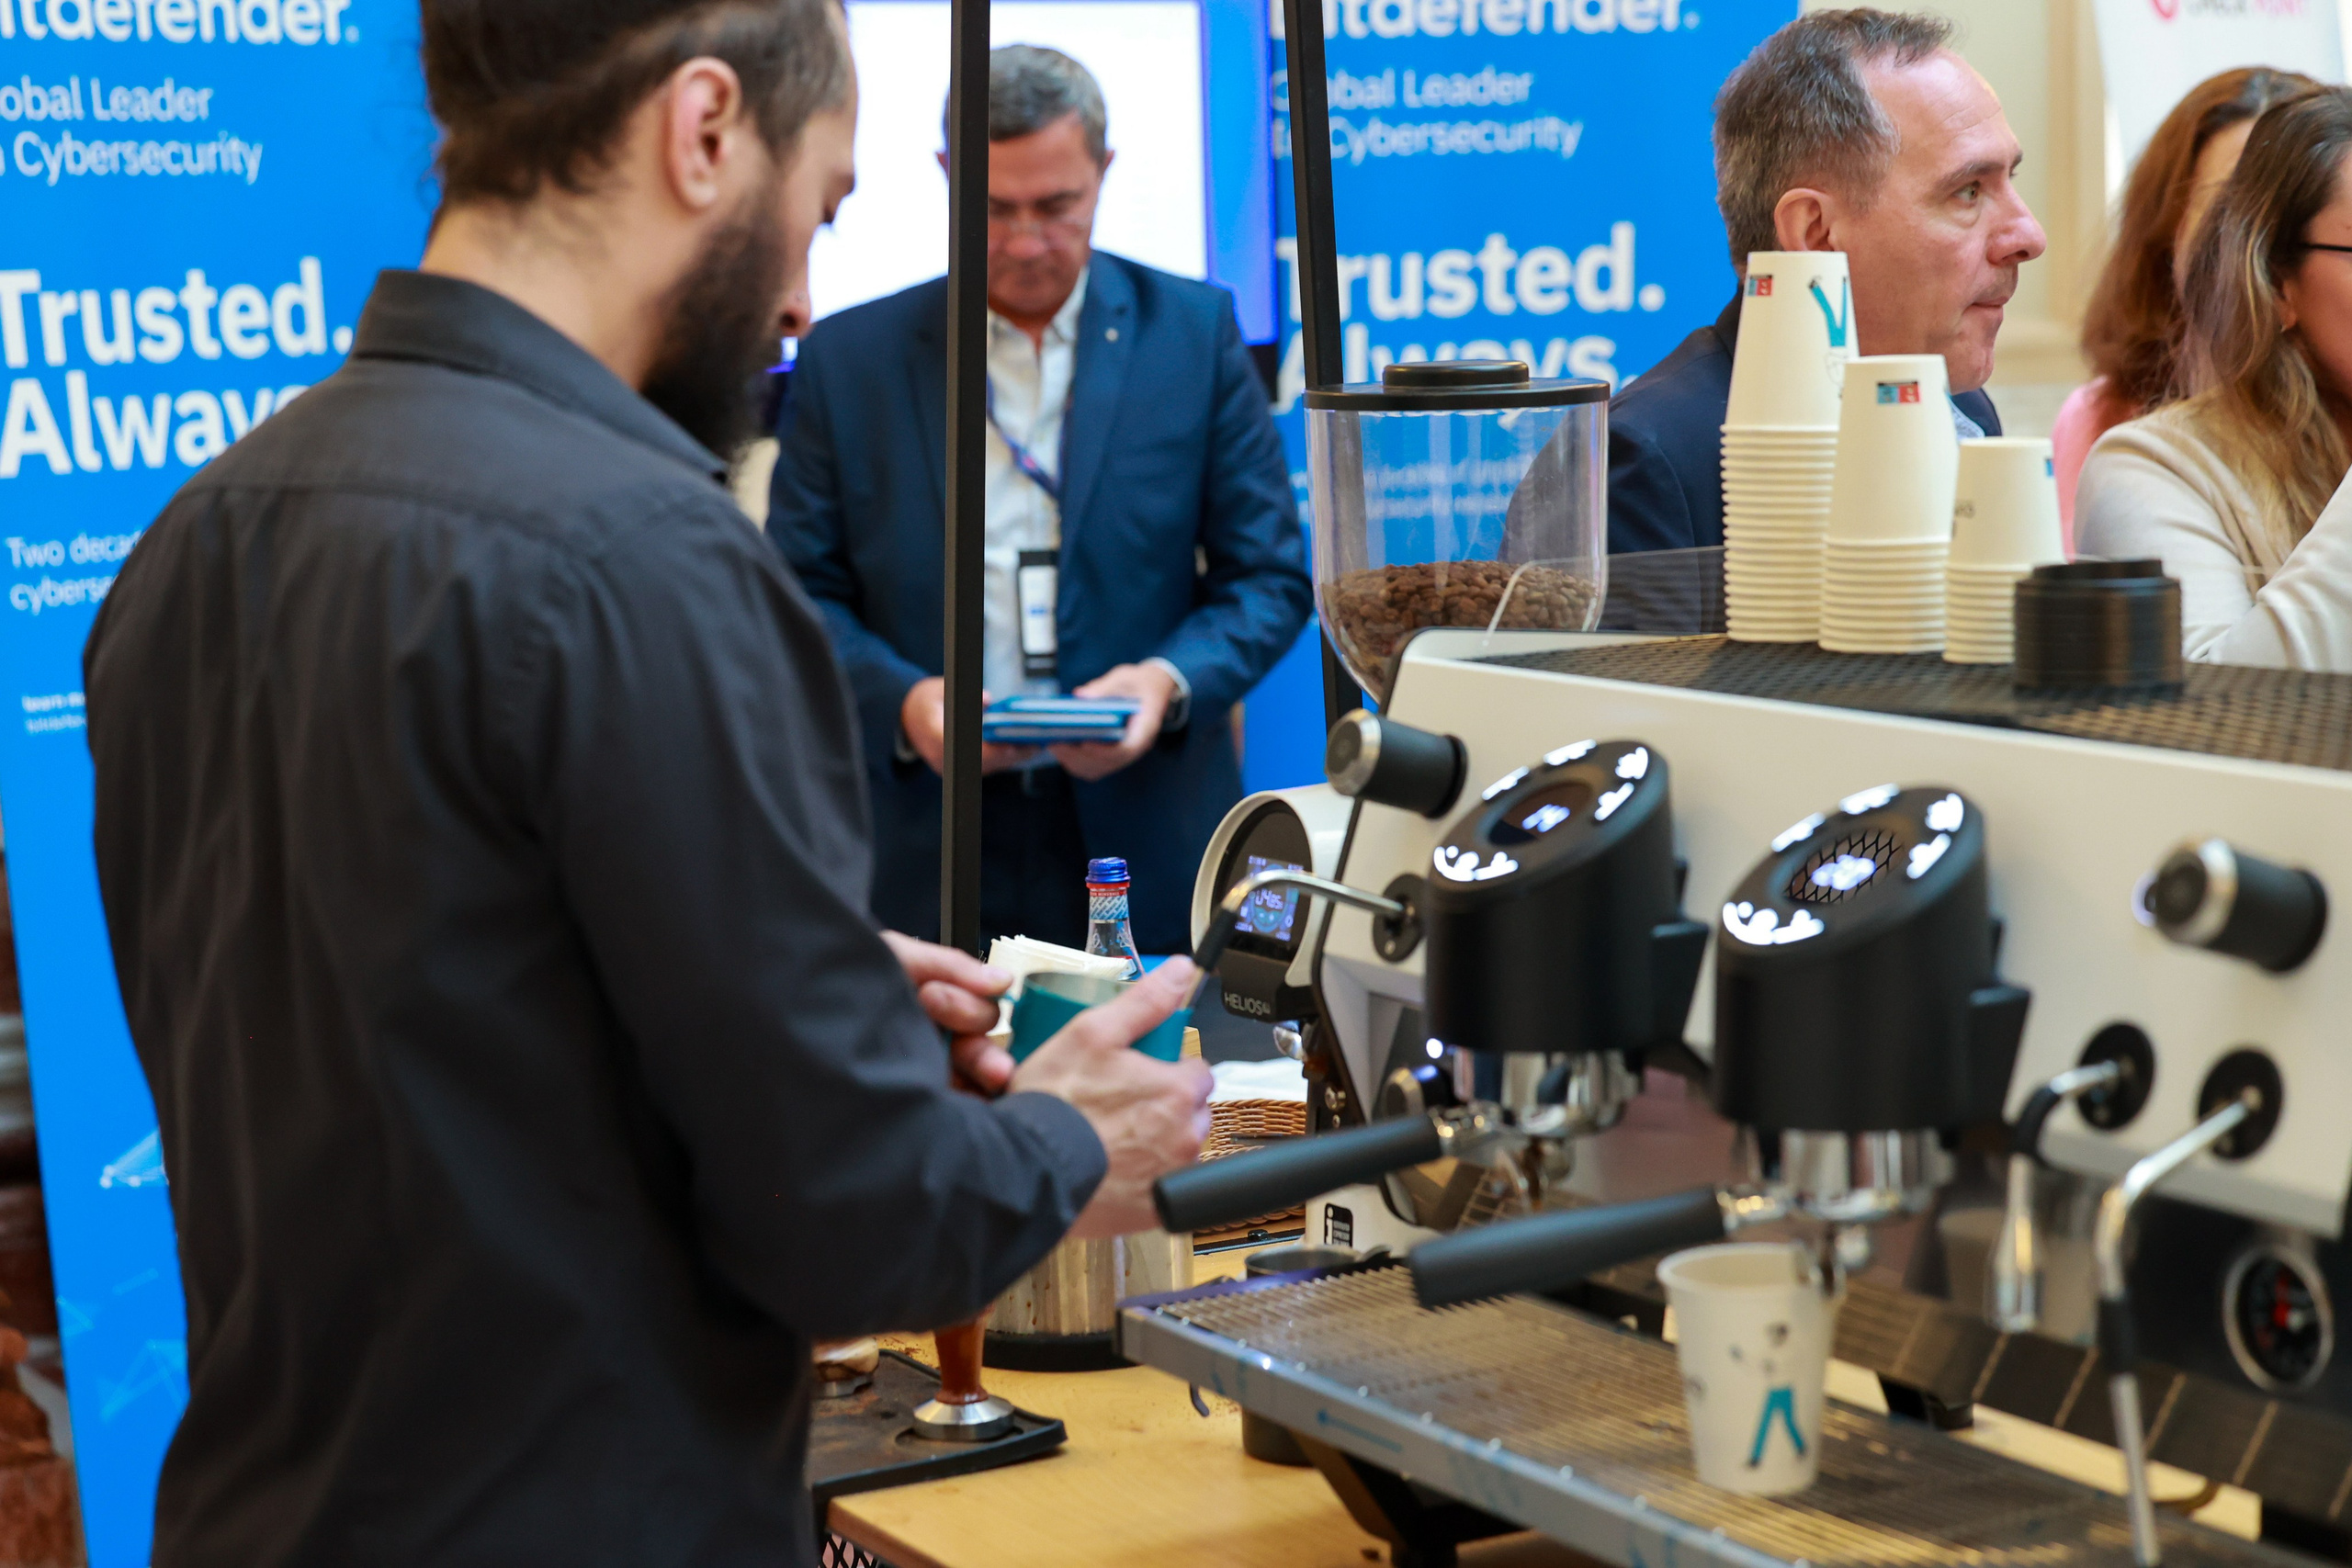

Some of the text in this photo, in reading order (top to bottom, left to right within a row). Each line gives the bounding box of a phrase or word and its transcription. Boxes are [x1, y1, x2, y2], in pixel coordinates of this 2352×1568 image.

[91, 77, 213, 121] Leader
[1403, 66, 1534, 107] Leader
[13, 130, 263, 186] Cybersecurity
[1329, 116, 1583, 164] Cybersecurity
[1275, 221, 1666, 321] Trusted.
[0, 256, 354, 367] Trusted.
[6, 536, 65, 568] Two
[1224, 992, 1263, 1016] HELIOS
